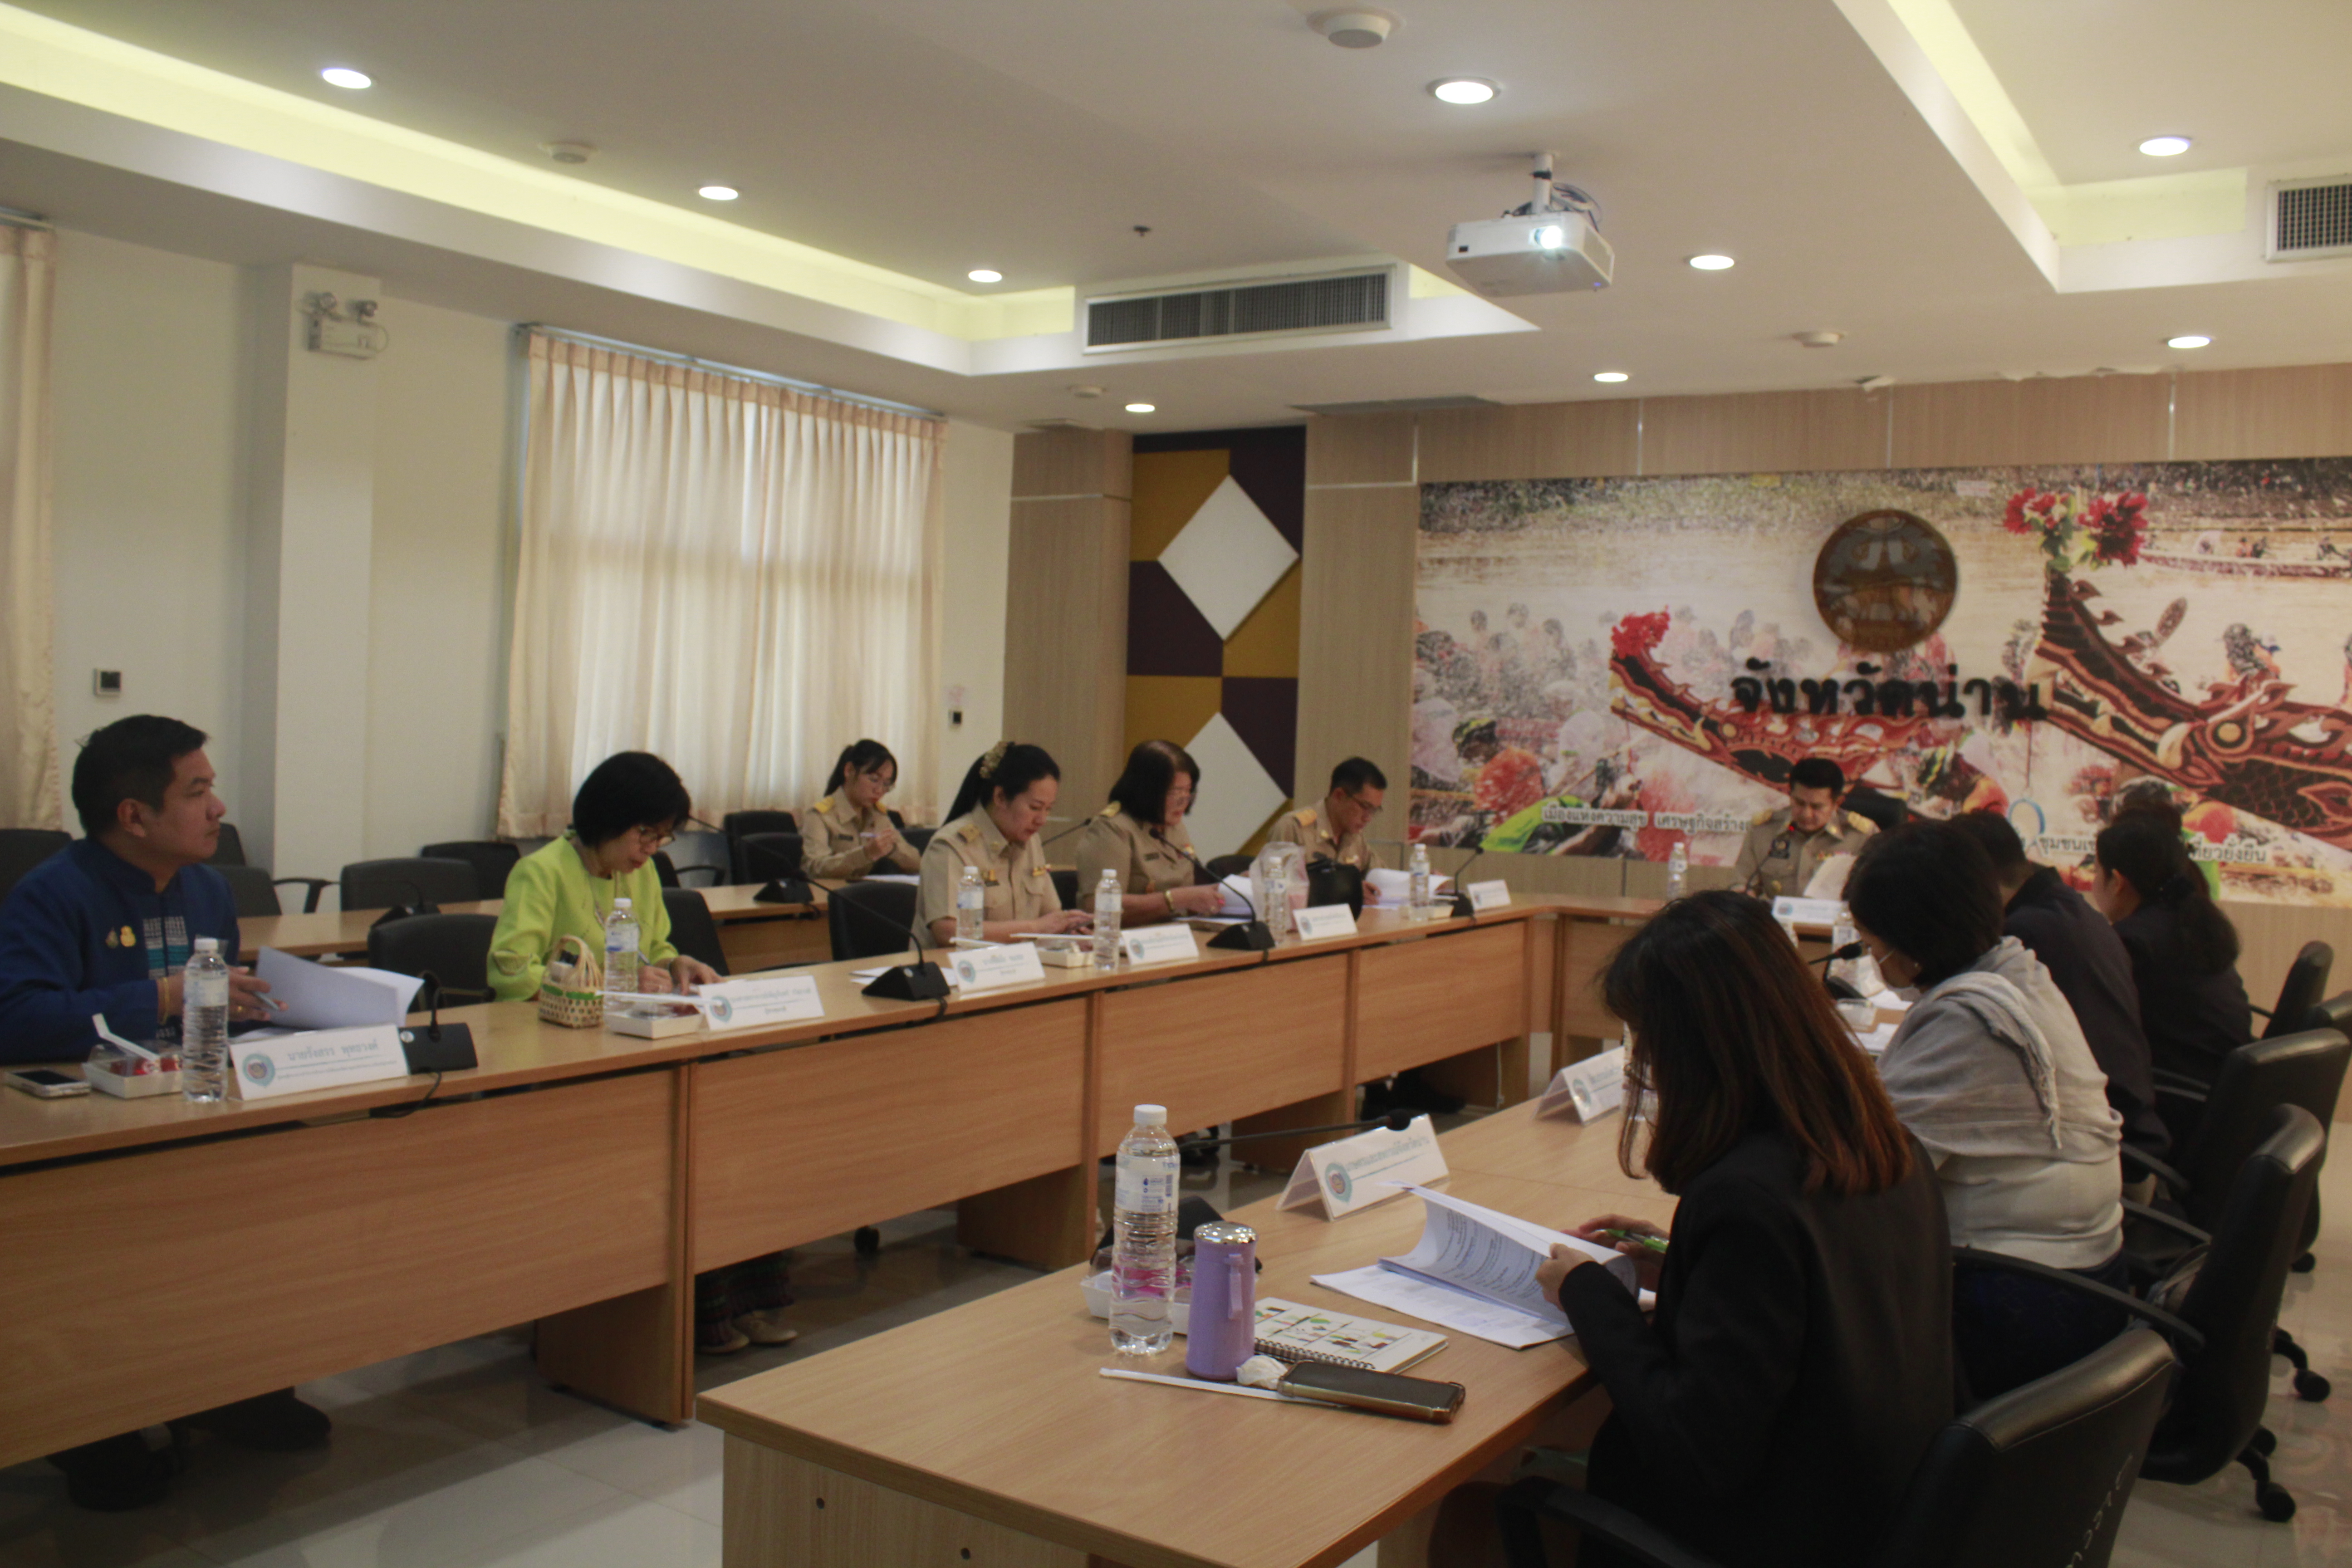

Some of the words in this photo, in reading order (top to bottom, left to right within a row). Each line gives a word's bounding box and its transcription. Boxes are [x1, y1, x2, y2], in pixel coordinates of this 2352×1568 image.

[1730, 657, 2048, 720] จังหวัดน่าน
[1544, 803, 1647, 831] เมืองแห่งความสุข
[2039, 837, 2096, 855] ชุมชนเข
